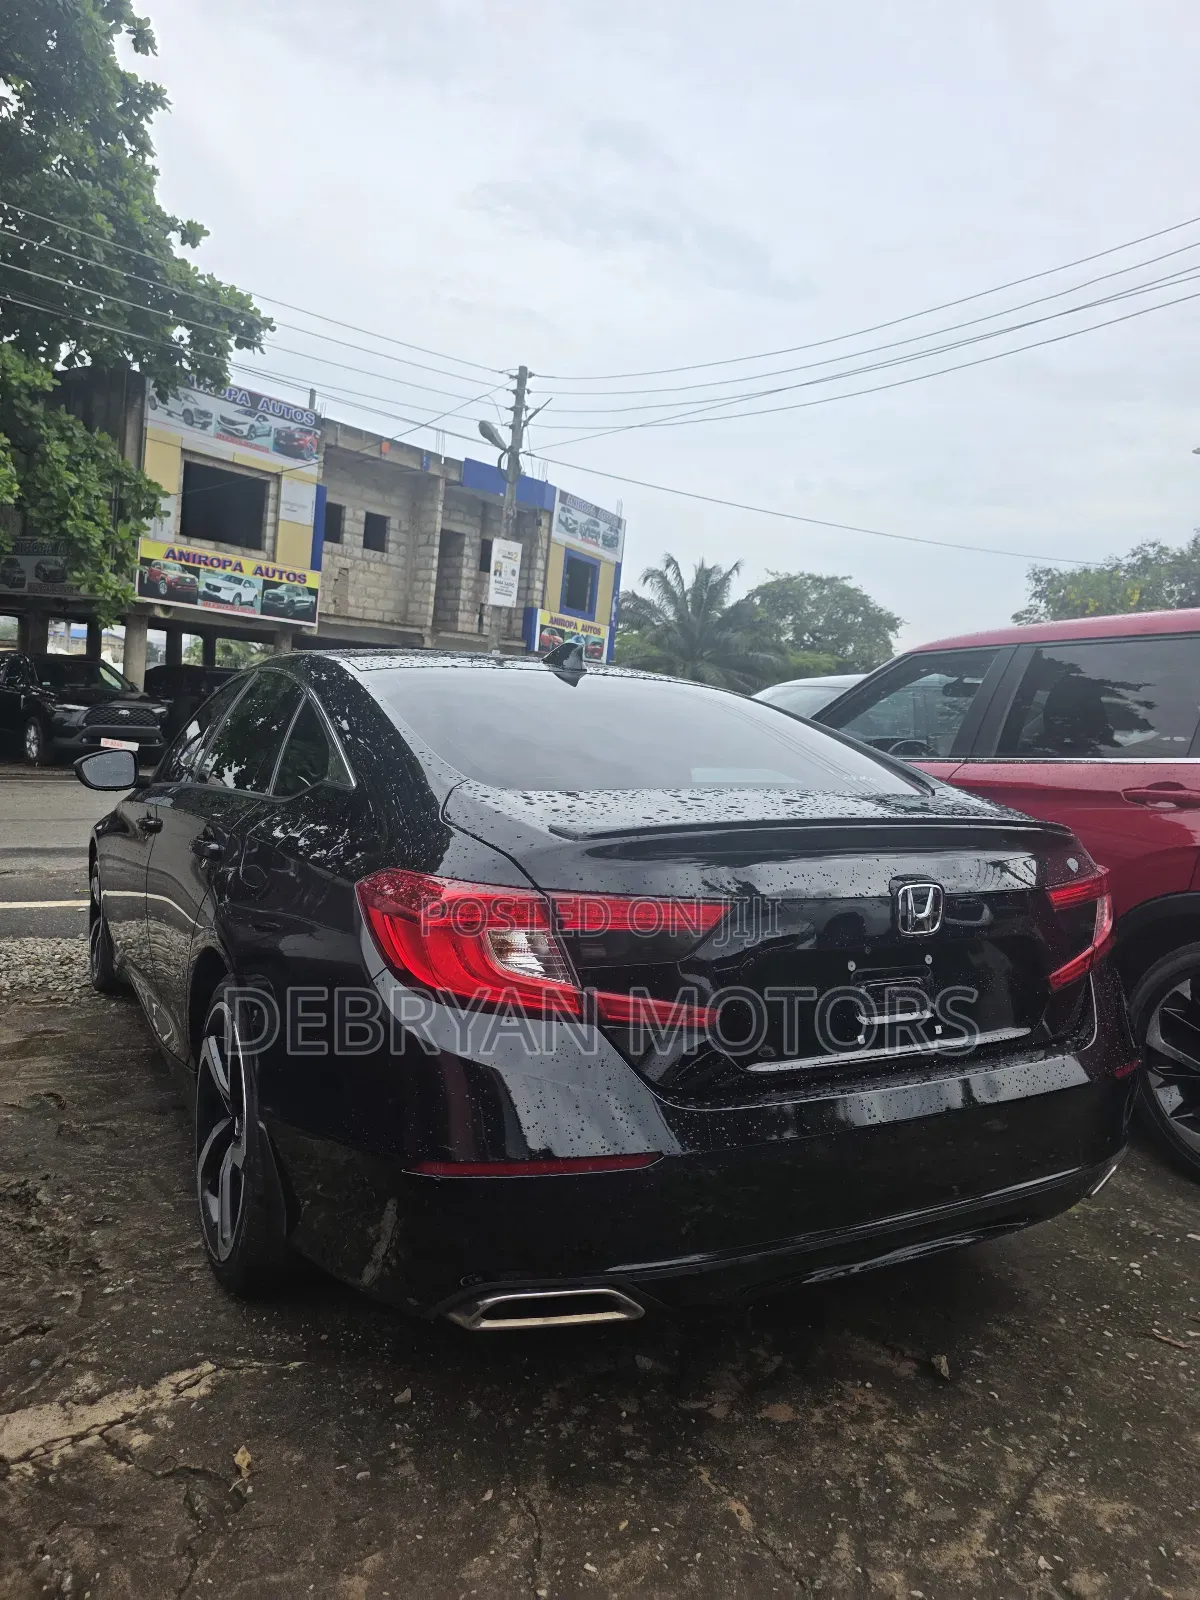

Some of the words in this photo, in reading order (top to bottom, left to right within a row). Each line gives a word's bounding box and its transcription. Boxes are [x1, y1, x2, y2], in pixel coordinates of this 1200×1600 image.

[258, 397, 315, 426] AUTOS
[163, 546, 244, 573] ANIROPA
[252, 565, 307, 585] AUTOS
[549, 615, 578, 631] ANIROPA
[580, 623, 602, 635] AUTOS
